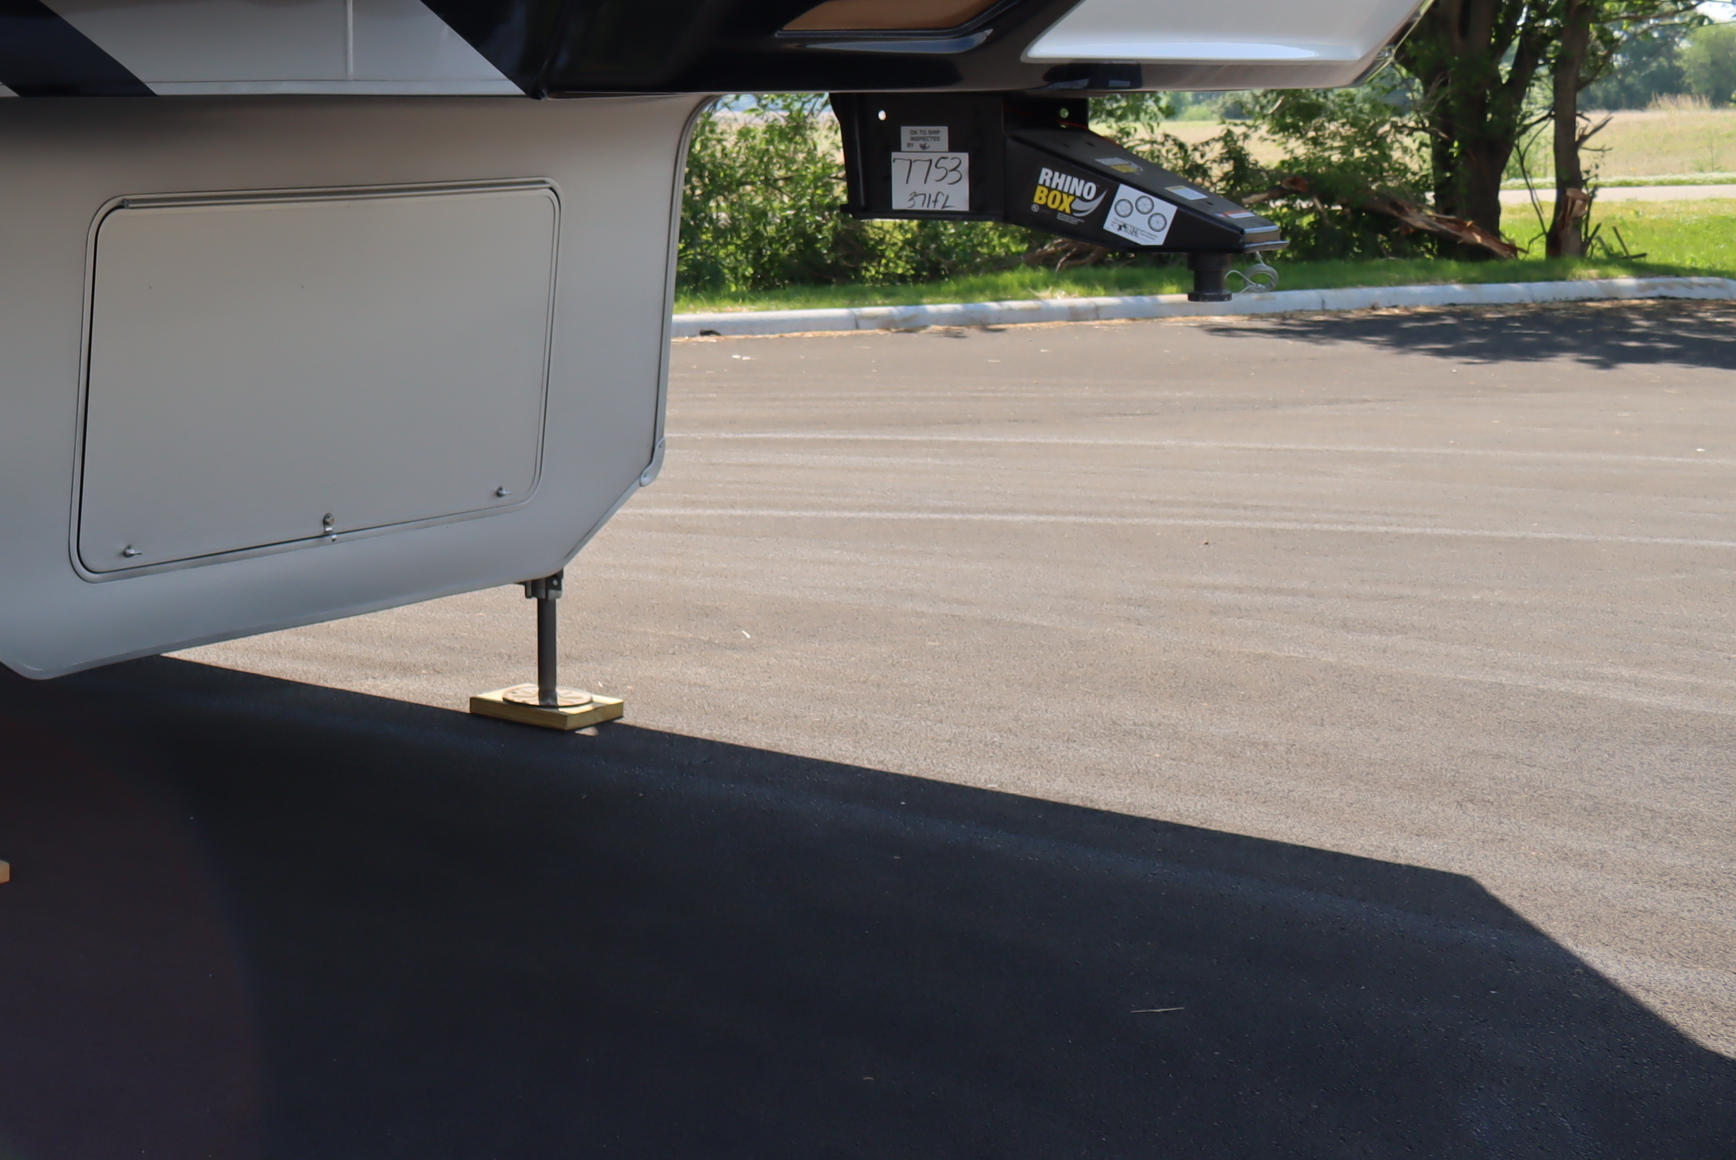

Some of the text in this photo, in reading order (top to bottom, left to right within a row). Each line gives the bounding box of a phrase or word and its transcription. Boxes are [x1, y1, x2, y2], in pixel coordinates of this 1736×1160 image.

[893, 156, 963, 185] 7753
[1038, 167, 1097, 200] RHINO
[1033, 185, 1077, 215] BOX
